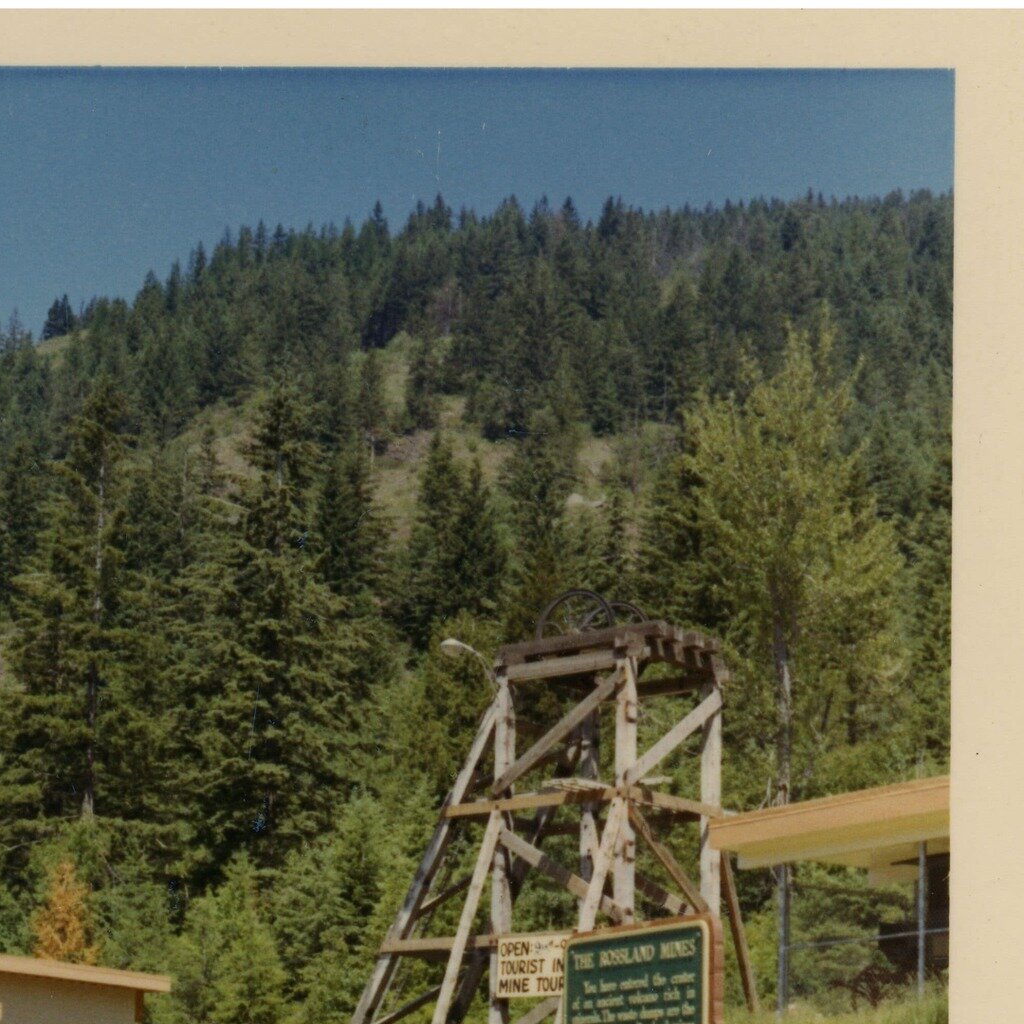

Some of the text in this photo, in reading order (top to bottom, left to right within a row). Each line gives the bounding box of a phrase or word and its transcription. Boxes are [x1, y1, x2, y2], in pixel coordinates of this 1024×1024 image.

[500, 941, 533, 957] OPEN:
[574, 938, 696, 971] THE ROSSLAND MINES
[501, 958, 545, 975] TOURIST
[499, 977, 530, 993] MINE
